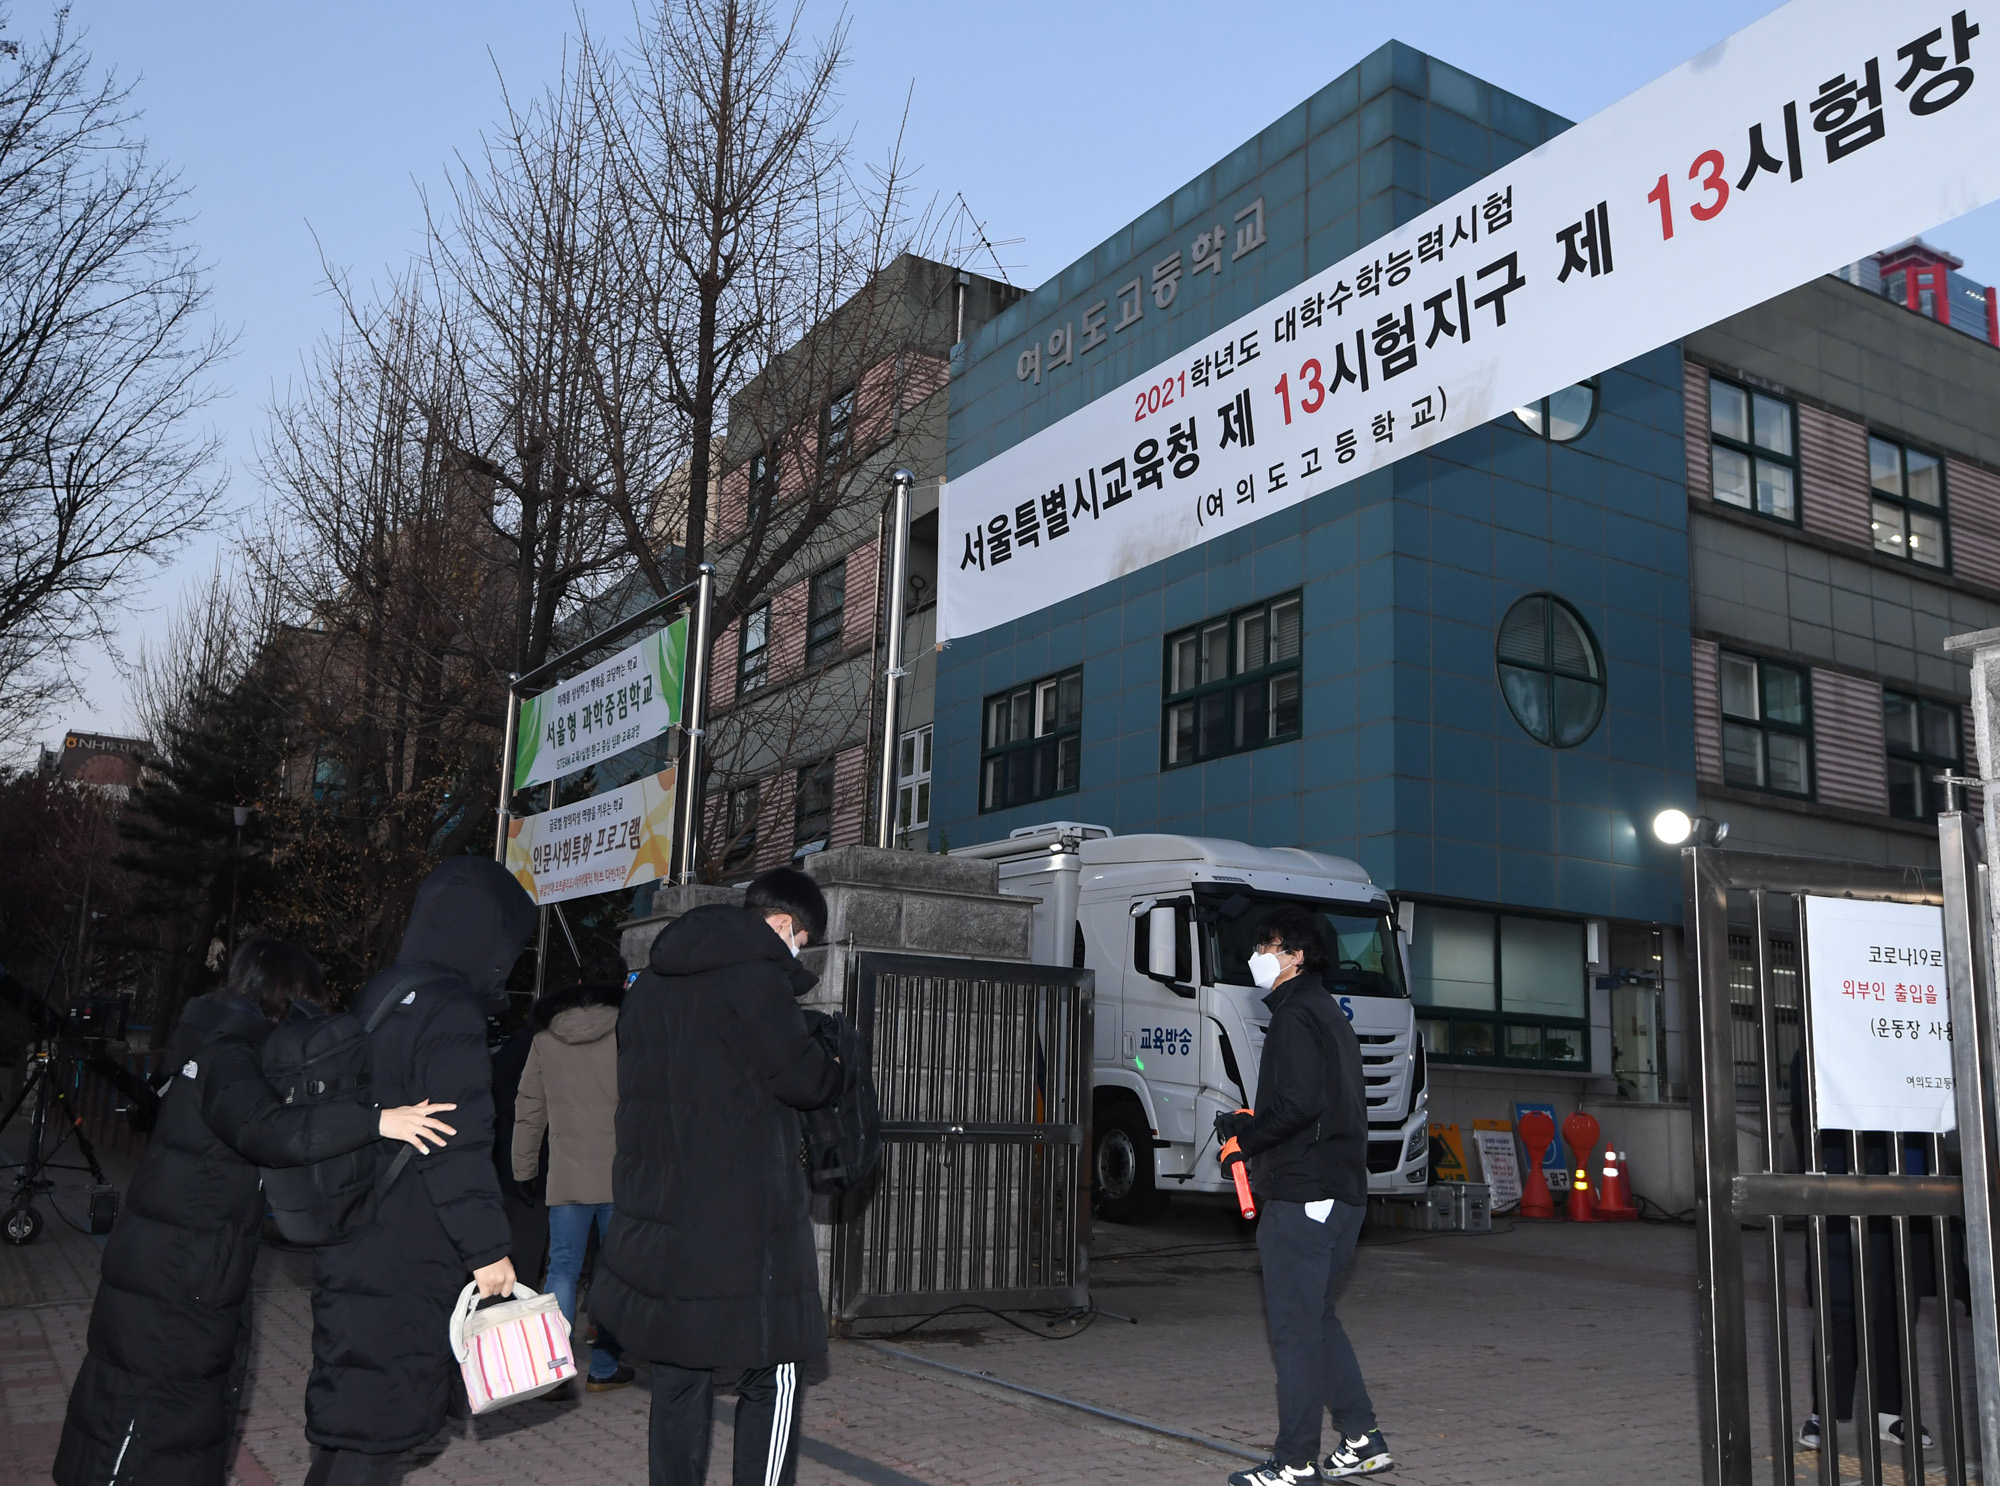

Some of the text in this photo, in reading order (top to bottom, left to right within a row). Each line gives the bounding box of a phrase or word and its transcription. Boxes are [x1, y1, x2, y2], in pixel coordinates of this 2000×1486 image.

[960, 9, 1980, 572] 서울특별시교육청 제 13시험지구 제 13시험장
[1016, 197, 1267, 385] 여의도고등학교
[1134, 184, 1514, 423] 2021학년도 대학수학능력시험
[590, 673, 605, 692] 행복을
[606, 664, 626, 682] 코딩하는
[627, 656, 638, 672] 학교
[546, 674, 653, 750] 서울형 과학중점학교
[549, 816, 562, 832] 글로벌
[582, 806, 596, 823] 역량을
[597, 801, 612, 819] 키우는
[613, 797, 624, 813] 학교
[533, 816, 641, 875] 인문사회특화 프로그램
[1868, 946, 1943, 967] 코로나19로
[1842, 980, 1885, 1001] 외부인
[1894, 983, 1937, 1005] 출입을
[1140, 1027, 1192, 1056] 교육방송
[1870, 1018, 1921, 1040] (운동장
[1906, 1076, 1957, 1090] 여의도고등
[1550, 1172, 1567, 1188] 입구
